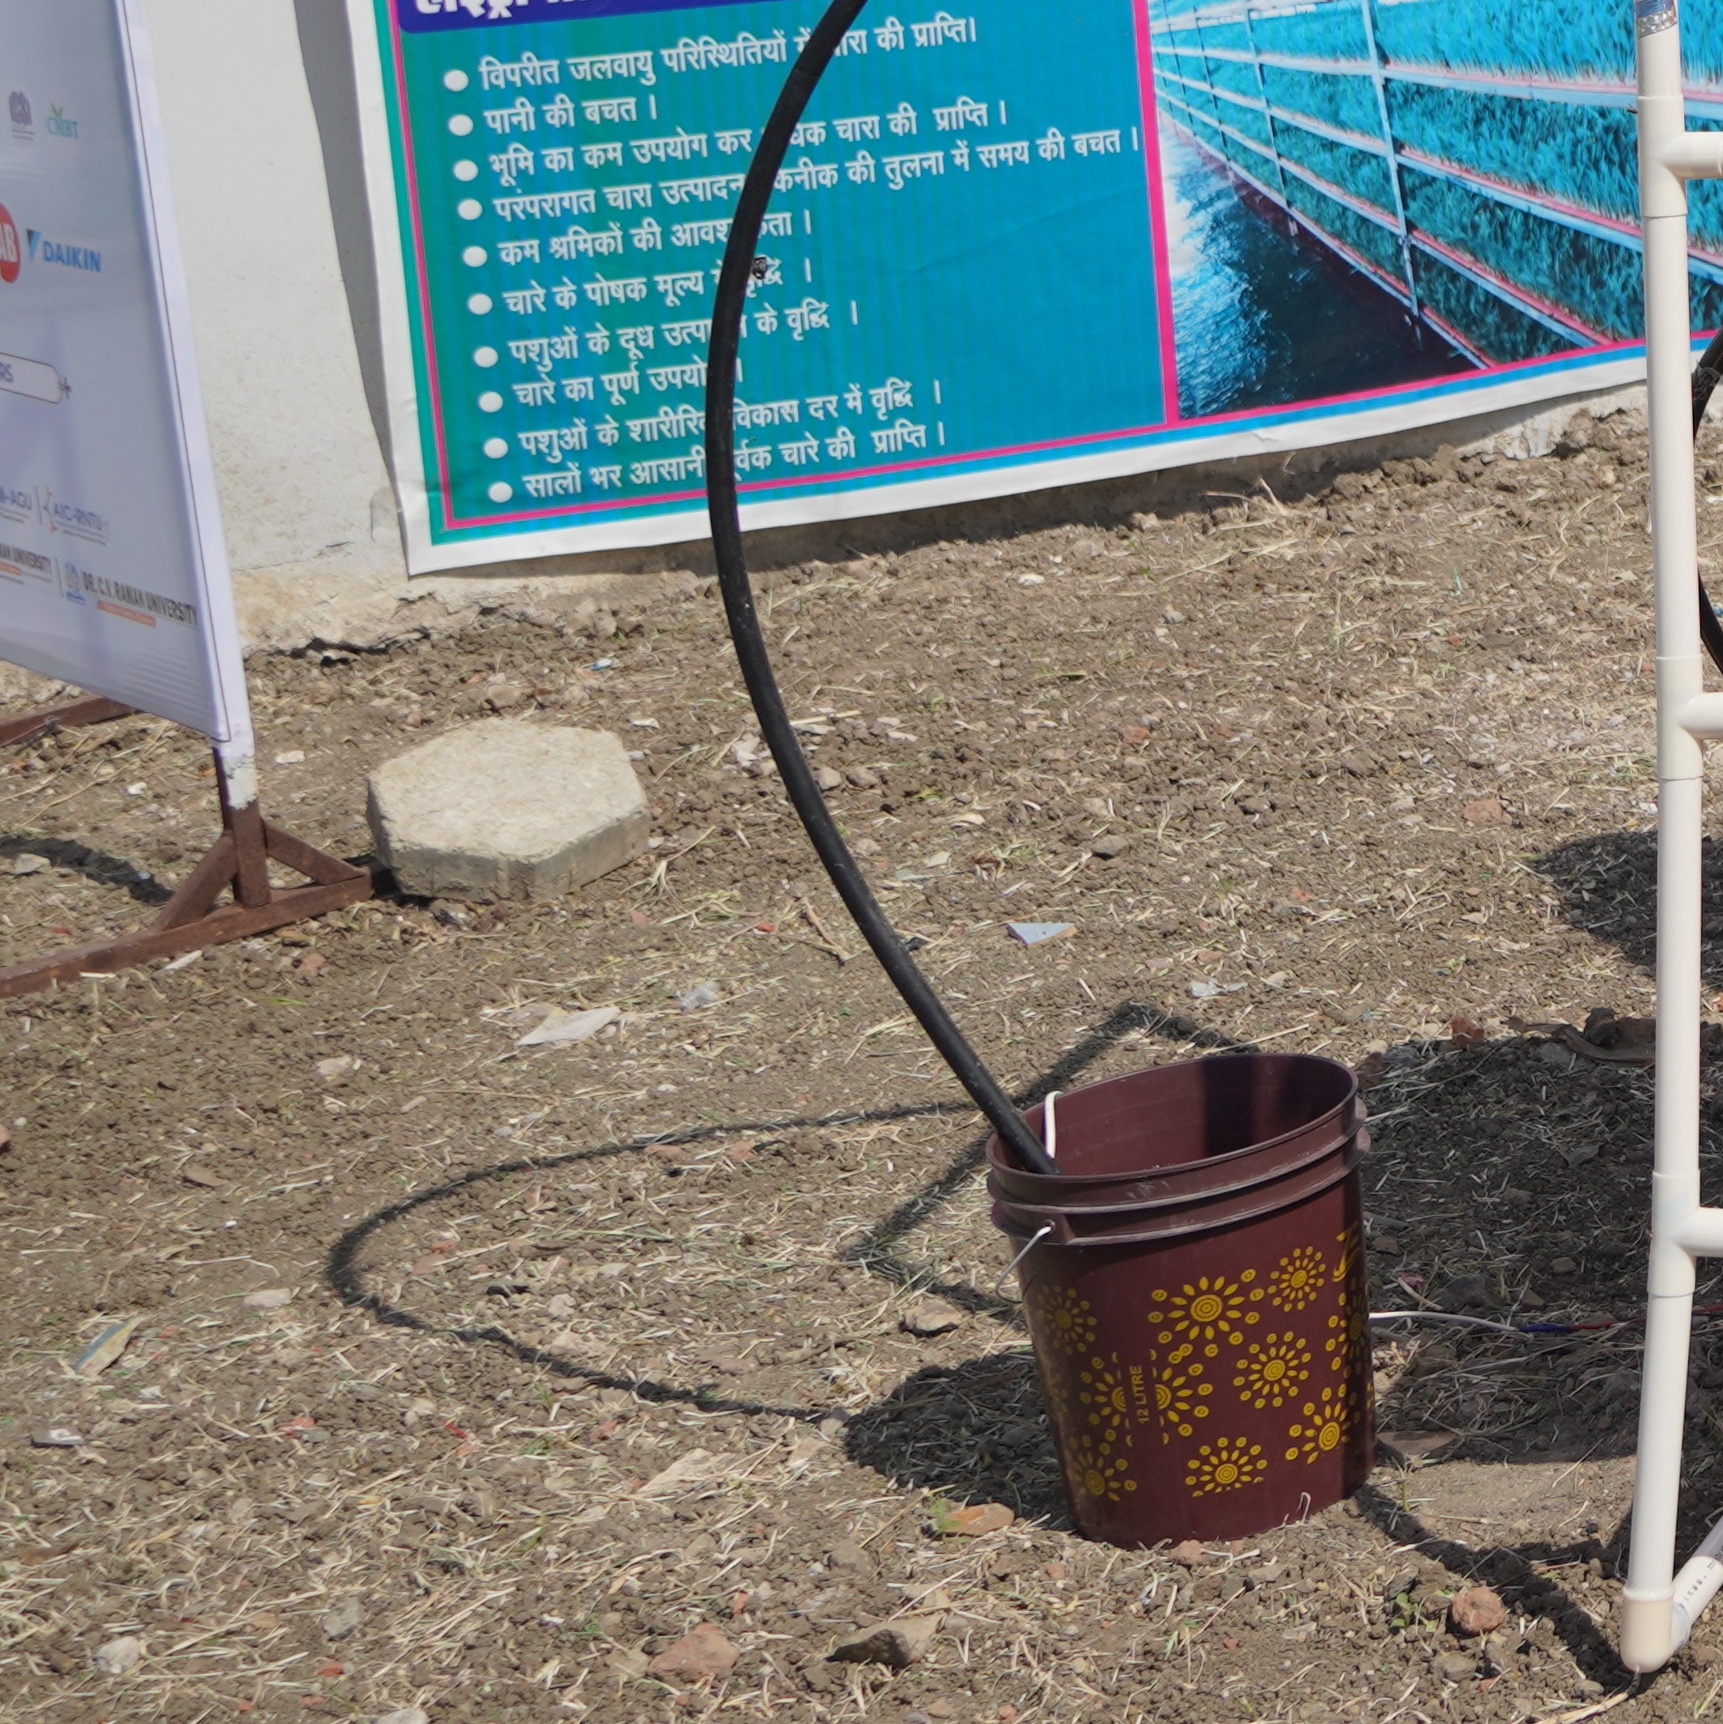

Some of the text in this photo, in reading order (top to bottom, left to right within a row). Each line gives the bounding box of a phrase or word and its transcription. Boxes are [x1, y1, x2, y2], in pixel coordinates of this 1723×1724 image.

[479, 51, 561, 91] विपरीत
[566, 50, 657, 87] जलवायु
[874, 16, 905, 51] की
[483, 93, 637, 135] पानी की बचत
[488, 95, 989, 187] भूमि का कम उपयोग कर चारा की प्राप्ति
[602, 184, 653, 212] चारा
[773, 156, 839, 194] कनीक
[846, 149, 876, 185] की
[883, 150, 945, 190] तुलना
[952, 139, 971, 172] में
[976, 140, 1030, 169] समय
[1036, 127, 1066, 162] की
[1072, 130, 1121, 158] बचत
[43, 240, 102, 274] DAIKIN
[498, 217, 662, 267] कम श्रमिकों की
[503, 280, 547, 316] चारे
[552, 277, 577, 310] के
[584, 273, 648, 307] पोषक
[654, 271, 705, 308] मूल्य
[508, 326, 579, 373] पशुओं
[585, 322, 610, 356] के
[617, 325, 655, 362] दूध
[754, 303, 778, 336] के
[512, 361, 641, 409] चारे का पूर्ण
[518, 418, 588, 464] पशुओं
[595, 414, 620, 447] के
[732, 396, 799, 431] विकास
[807, 395, 838, 421] दर
[844, 382, 863, 416] में
[522, 418, 928, 499] सालों भर आसानी चारे की प्राप्ति
[145, 591, 199, 626] UNIVERSITY
[1130, 1365, 1149, 1423] 12 LITRE
